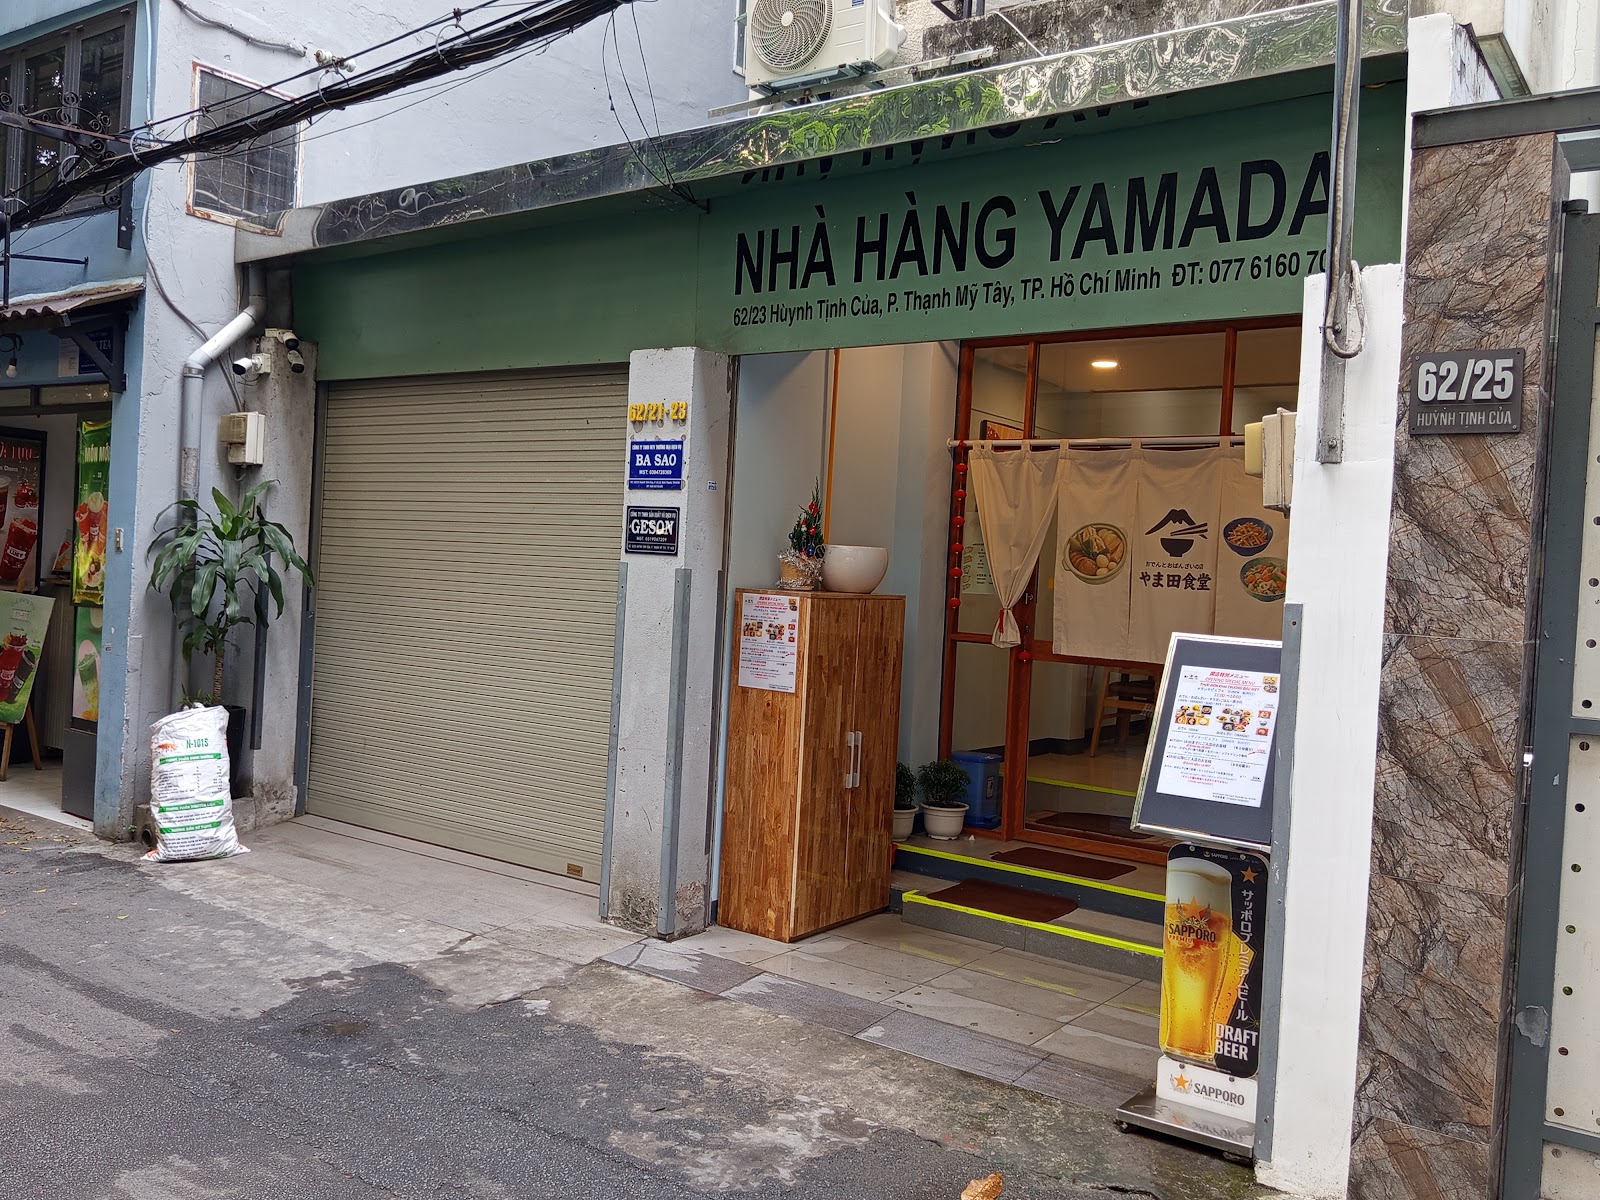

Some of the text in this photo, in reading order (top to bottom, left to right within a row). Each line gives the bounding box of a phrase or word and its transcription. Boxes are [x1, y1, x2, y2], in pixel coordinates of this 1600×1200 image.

[734, 150, 1331, 296] NHÀ HÀNG YAMADA
[733, 303, 767, 327] 62/23
[816, 297, 847, 323] Tịnh
[850, 293, 883, 319] Của,
[887, 292, 899, 313] P.
[903, 287, 951, 316] Thạnh
[956, 282, 979, 311] Mỹ
[982, 280, 1015, 308] Tây,
[1021, 277, 1045, 301] TP.
[1050, 272, 1075, 298] Hồ
[1079, 269, 1110, 296] Chí
[1114, 266, 1161, 293] Minh
[1172, 261, 1204, 288] ĐT:
[1208, 256, 1246, 285] 077
[1250, 251, 1301, 281] 6160
[1417, 358, 1514, 402] 62/25
[1416, 406, 1512, 428] HUỲNH TỊNH CỦA
[635, 453, 677, 467] BA SAO
[631, 519, 675, 536] GESON
[1139, 571, 1212, 591] やま田食堂
[186, 737, 209, 749] N-101S
[1168, 922, 1216, 943] SAPPORO
[1236, 889, 1254, 1021] サッポロプレミアムビール
[1215, 1022, 1258, 1047] DRAFT
[1215, 1038, 1249, 1061] BEER
[1193, 1082, 1245, 1106] SAPPORO
